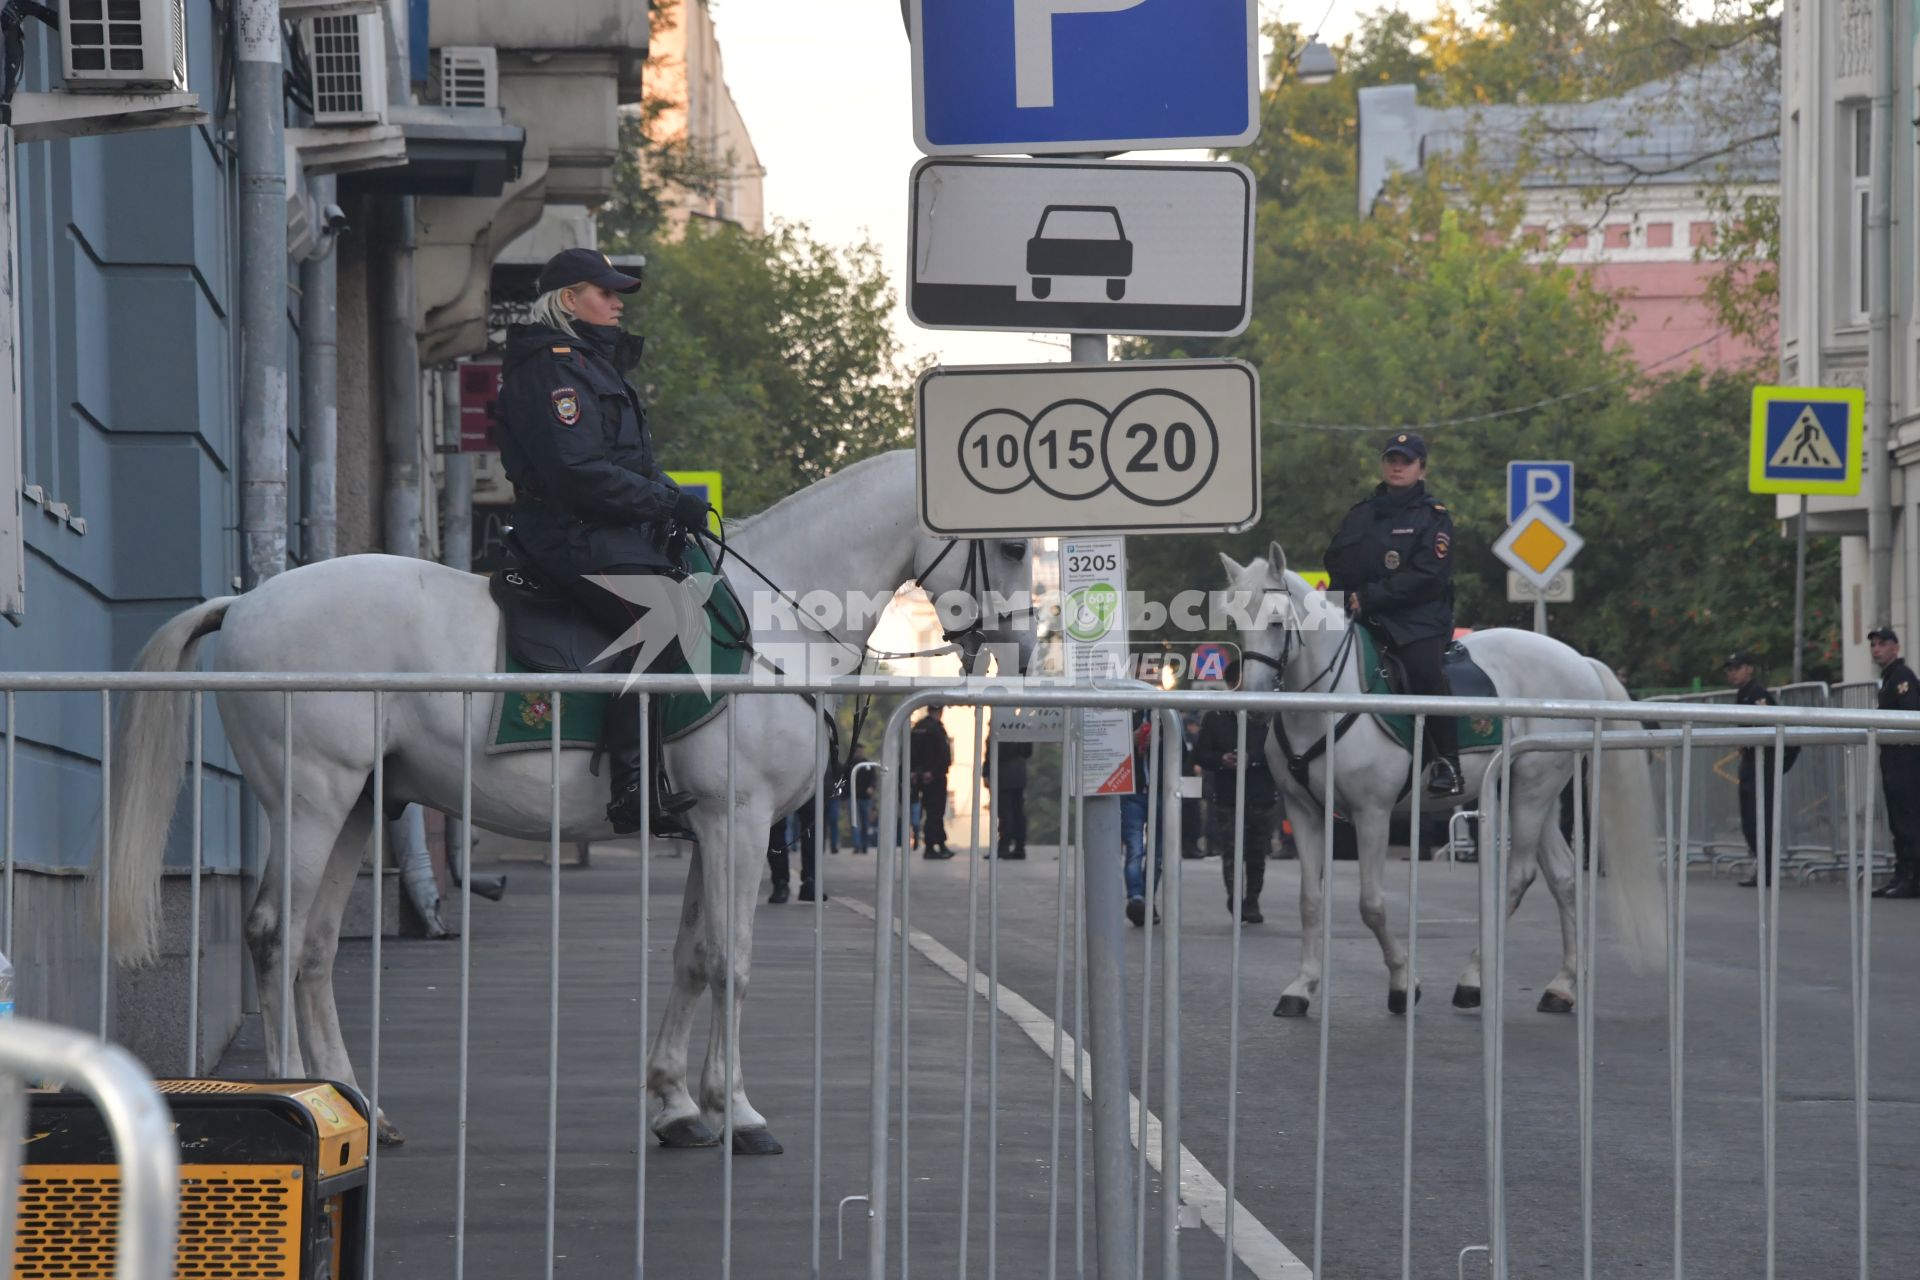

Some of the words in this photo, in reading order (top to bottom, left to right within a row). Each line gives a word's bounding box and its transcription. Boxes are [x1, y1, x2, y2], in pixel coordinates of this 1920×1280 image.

[972, 434, 1019, 468] 10
[1038, 429, 1095, 469] 15
[1125, 422, 1196, 472] 20
[1526, 469, 1562, 507] P
[1069, 554, 1116, 572] 3205
[1088, 592, 1104, 605] 60
